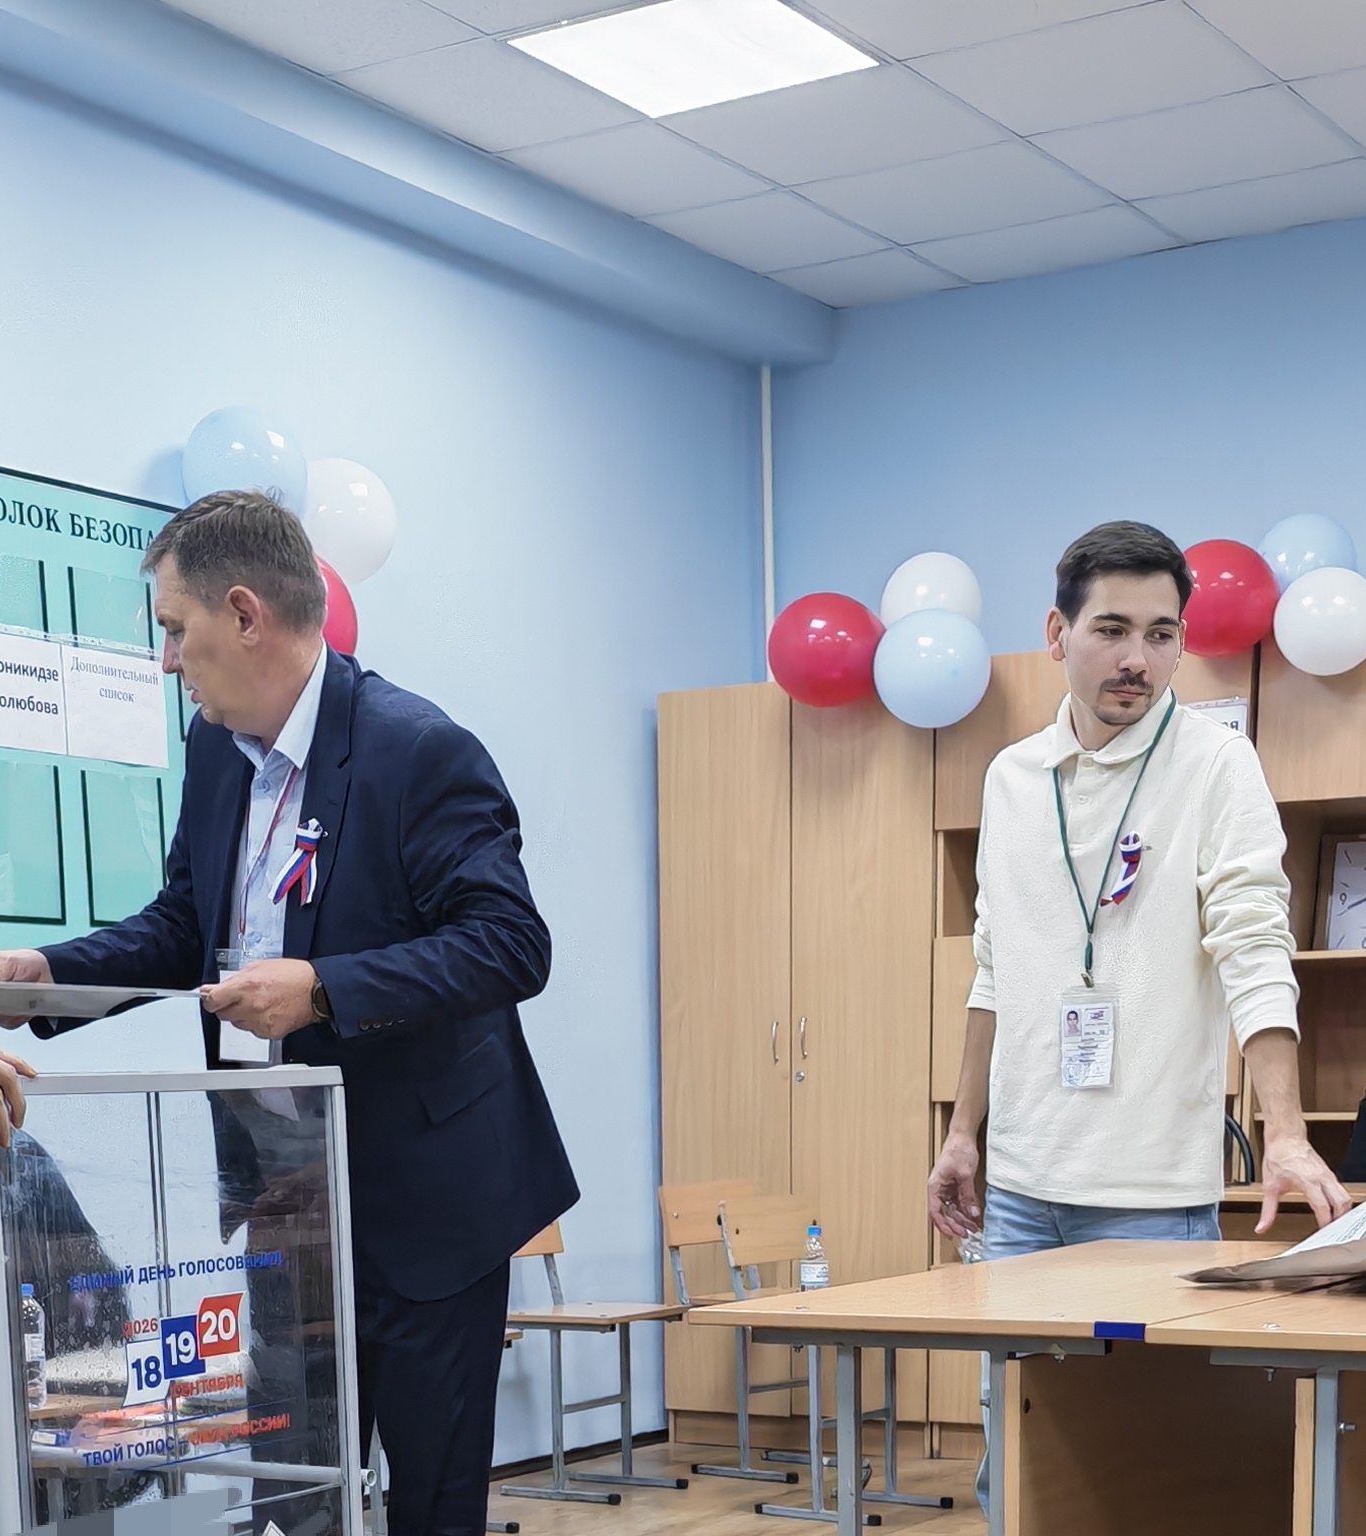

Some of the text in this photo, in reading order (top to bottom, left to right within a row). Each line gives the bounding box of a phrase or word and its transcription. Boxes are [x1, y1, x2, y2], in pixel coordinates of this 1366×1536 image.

[70, 656, 159, 686] Дополнительный
[99, 687, 134, 702] список
[138, 1265, 176, 1285] ДЕНЬ
[200, 1309, 236, 1344] 20
[165, 1331, 195, 1366] 19
[131, 1355, 162, 1391] 18
[83, 1443, 123, 1466] ТВОЙ
[127, 1436, 175, 1459] ГОЛОС
